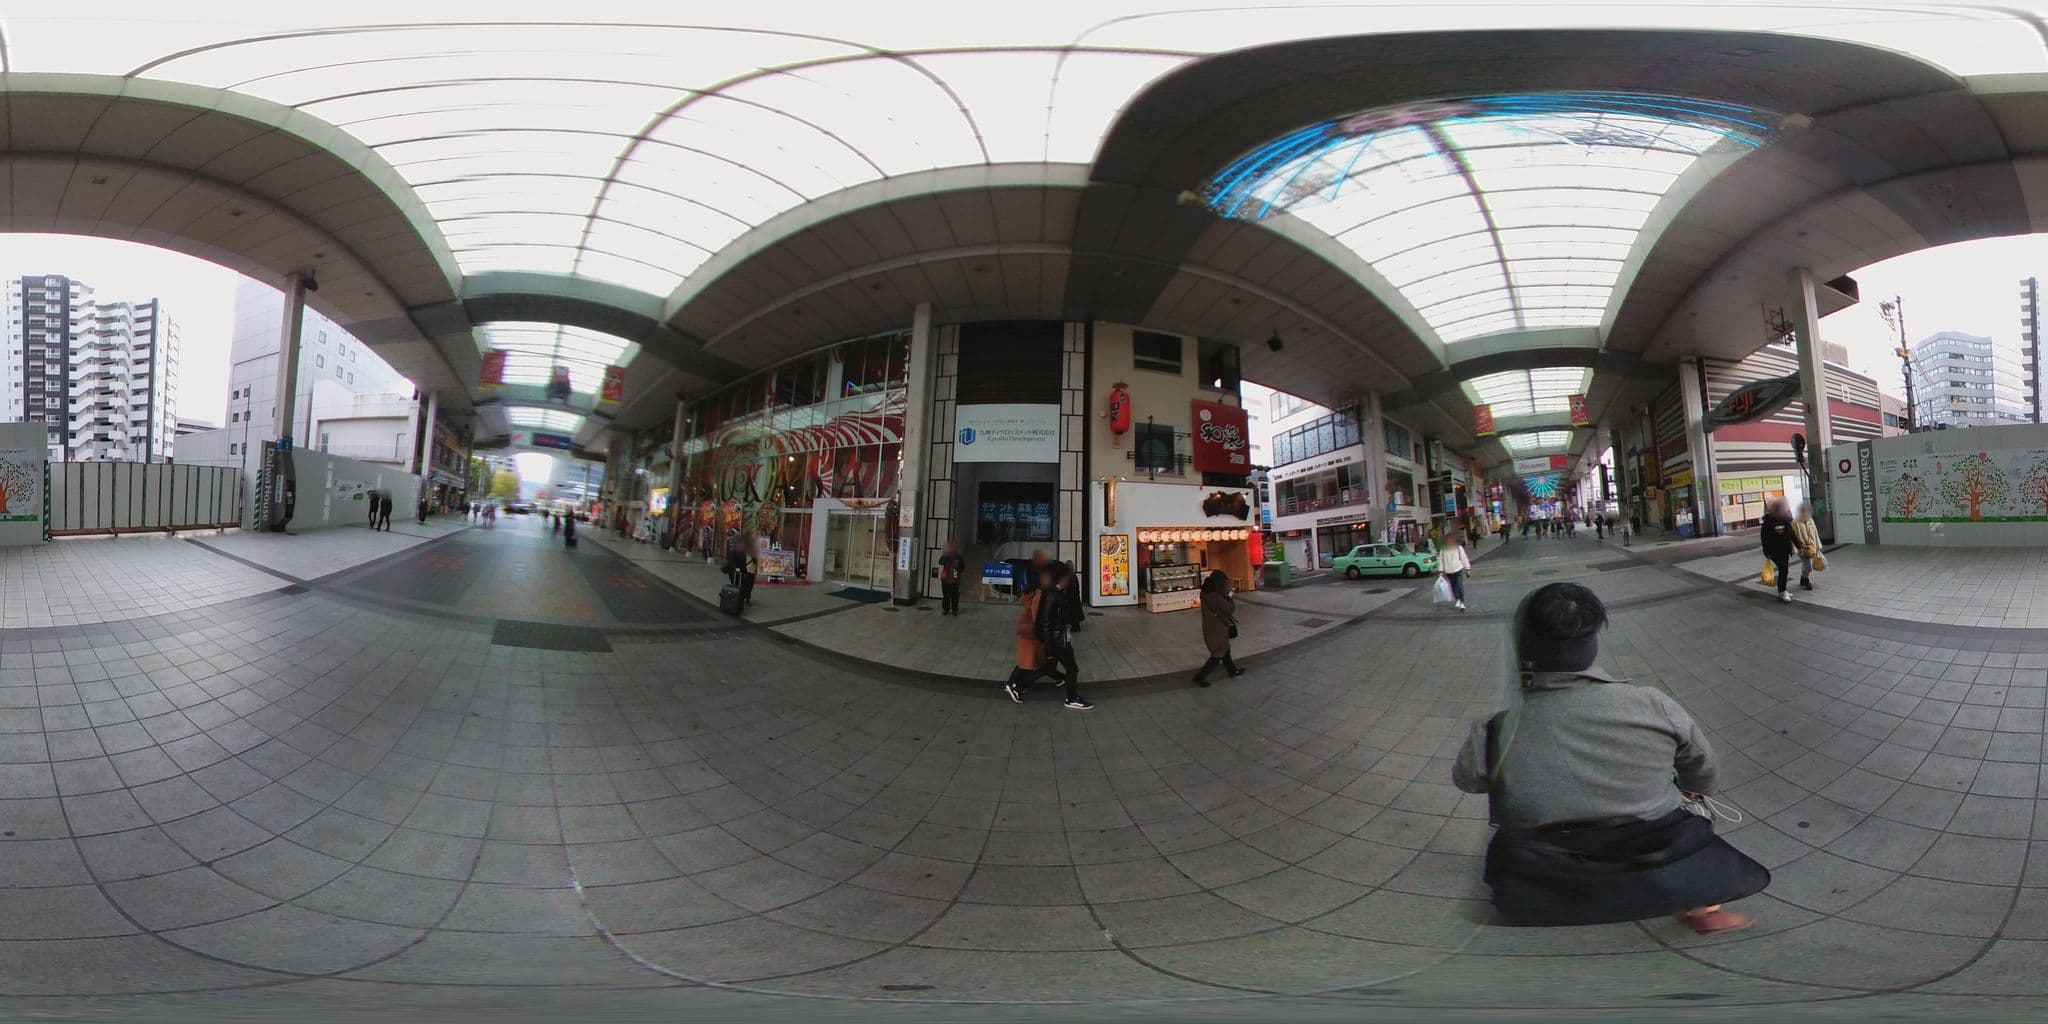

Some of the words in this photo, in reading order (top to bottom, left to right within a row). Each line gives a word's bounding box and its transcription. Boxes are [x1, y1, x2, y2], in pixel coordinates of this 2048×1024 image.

[264, 448, 275, 484] Daiwa
[1860, 448, 1872, 490] Daiwa
[262, 484, 272, 521] House
[1863, 491, 1875, 533] House
